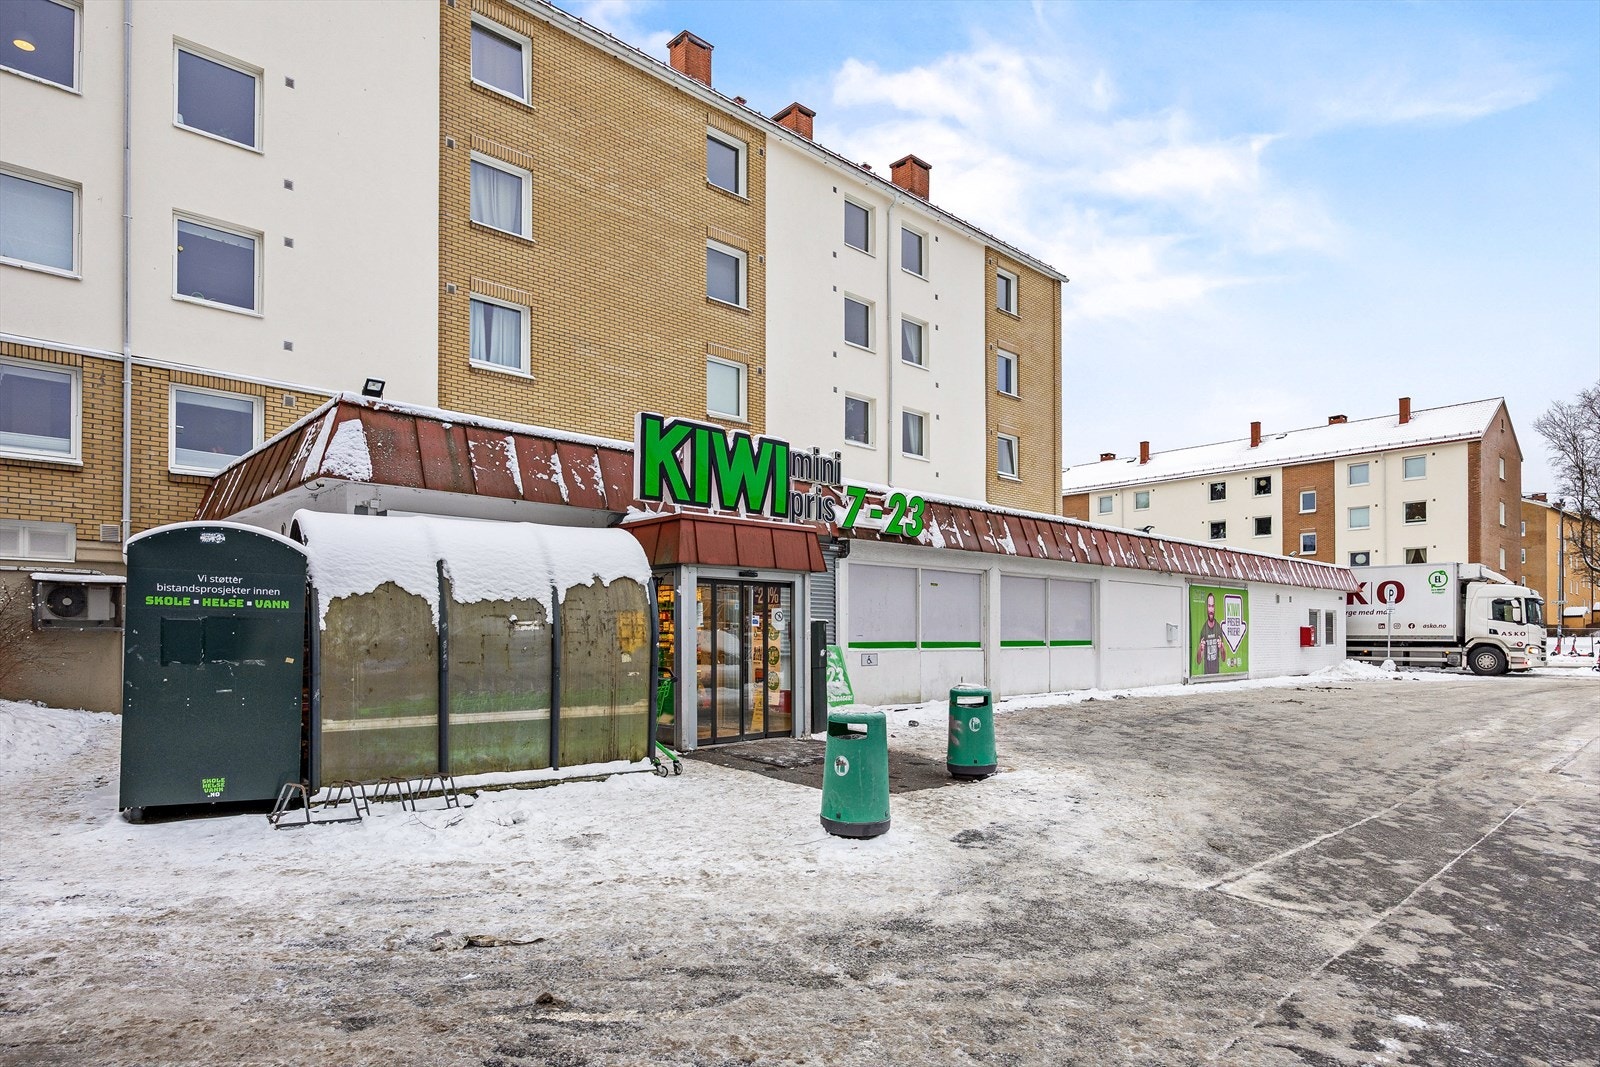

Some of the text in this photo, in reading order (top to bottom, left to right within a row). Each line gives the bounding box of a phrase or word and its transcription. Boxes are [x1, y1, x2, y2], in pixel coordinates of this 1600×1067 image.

[639, 412, 790, 519] KIWI
[790, 447, 841, 485] mini
[789, 486, 836, 523] pris
[197, 574, 243, 584] Vi støtter
[1434, 575, 1442, 583] EL
[156, 583, 281, 596] bistandsprosjekter innen
[145, 596, 290, 609] SKOLE HELSE VANN
[1422, 622, 1447, 630] asko.no
